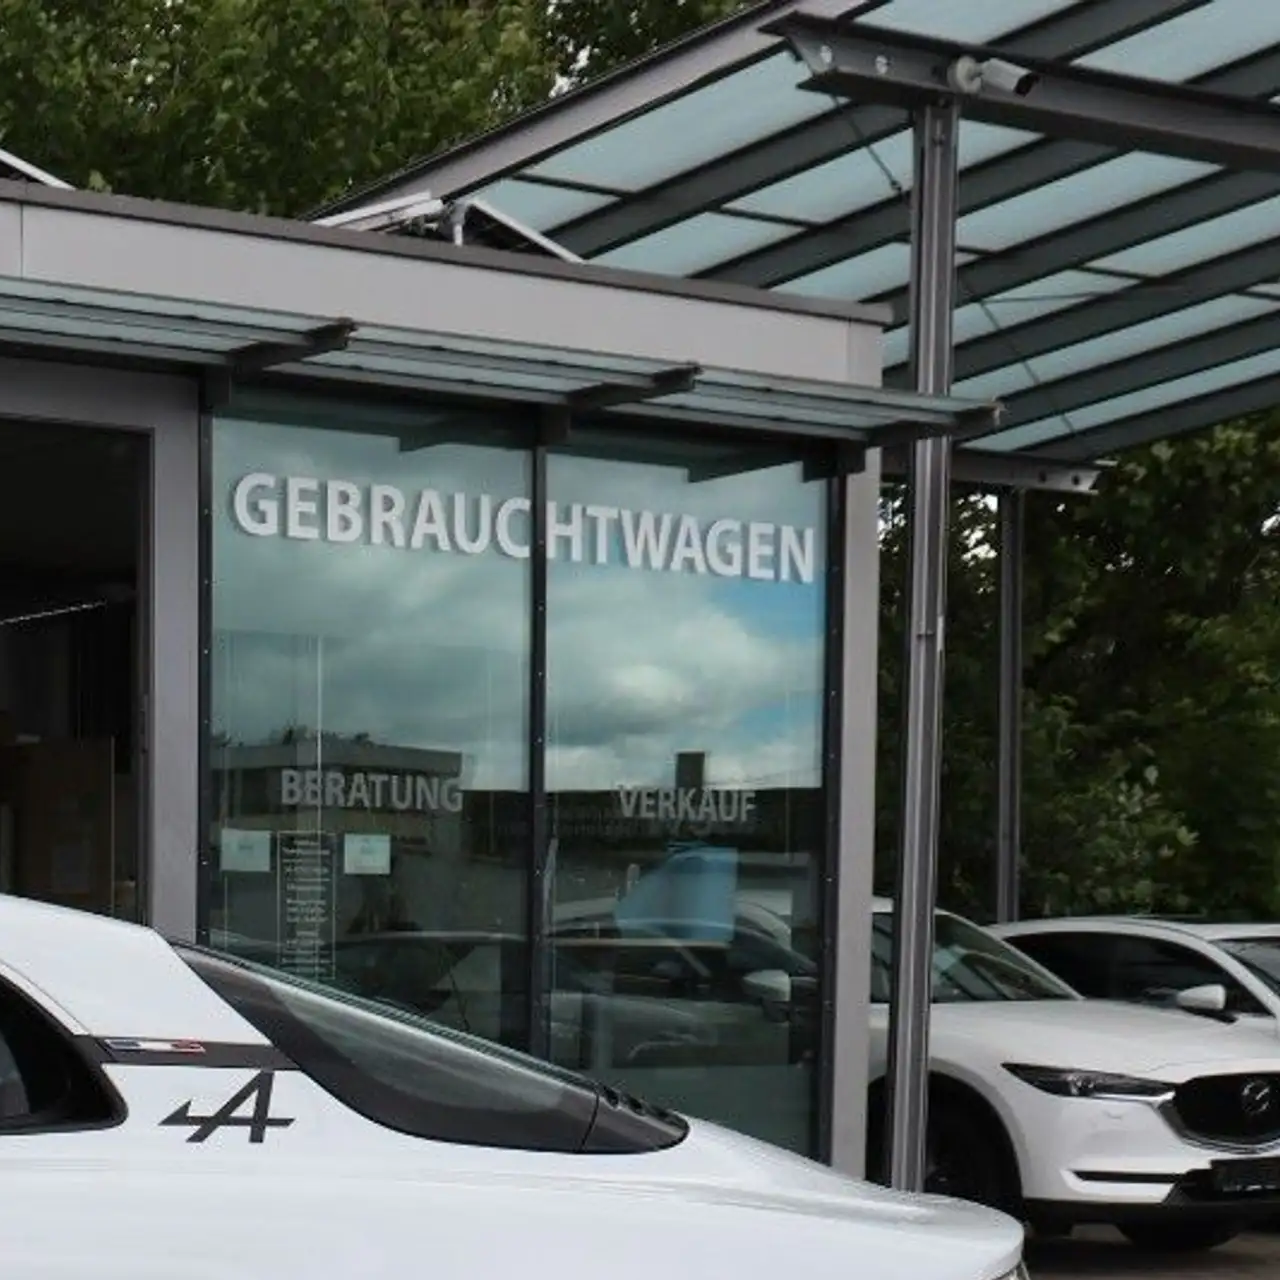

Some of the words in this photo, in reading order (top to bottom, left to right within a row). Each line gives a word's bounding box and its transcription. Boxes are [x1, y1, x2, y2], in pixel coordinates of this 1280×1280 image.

[233, 472, 815, 584] GEBRAUCHTWAGEN
[281, 768, 463, 812] BERATUNG
[617, 785, 756, 822] VERKAUF
